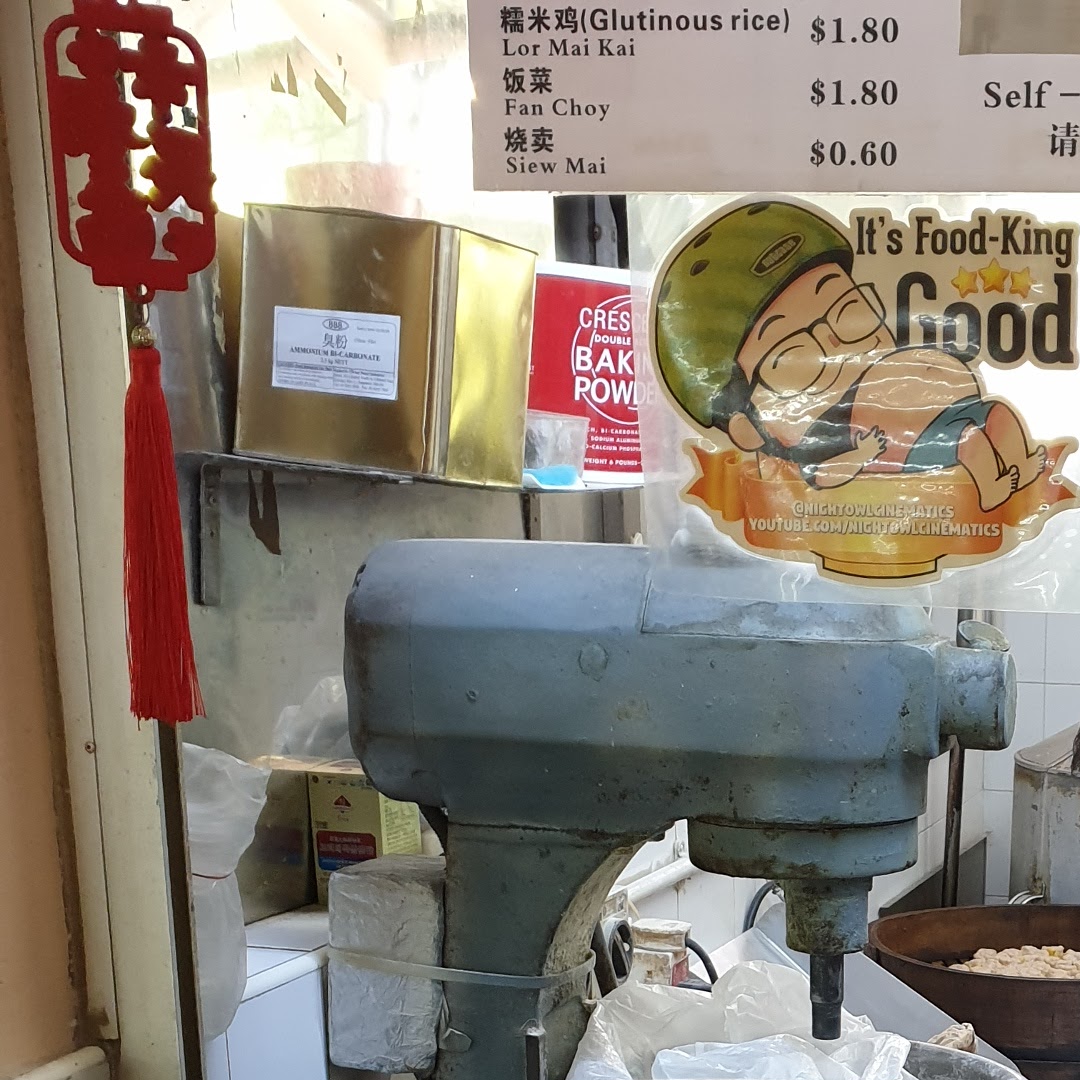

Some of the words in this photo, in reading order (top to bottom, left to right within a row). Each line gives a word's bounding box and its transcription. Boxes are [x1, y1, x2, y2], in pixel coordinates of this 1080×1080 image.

[731, 7, 790, 34] rice)
[810, 15, 899, 46] $1.80
[502, 38, 541, 57] Lor
[548, 37, 590, 57] Mai
[597, 37, 636, 57] Kai
[502, 66, 553, 95] 饭菜
[810, 77, 898, 108] $1.80
[983, 80, 1053, 109] Self
[504, 98, 544, 116] Fan
[551, 97, 610, 122] Choy
[503, 126, 555, 154] 烧卖
[809, 138, 898, 168] $0.60
[506, 155, 558, 174] Siew
[565, 156, 606, 175] Mai
[915, 215, 1074, 268] Food-King
[896, 271, 1074, 363] Good
[792, 501, 955, 519] @NIGHTOWLCINEMATICS
